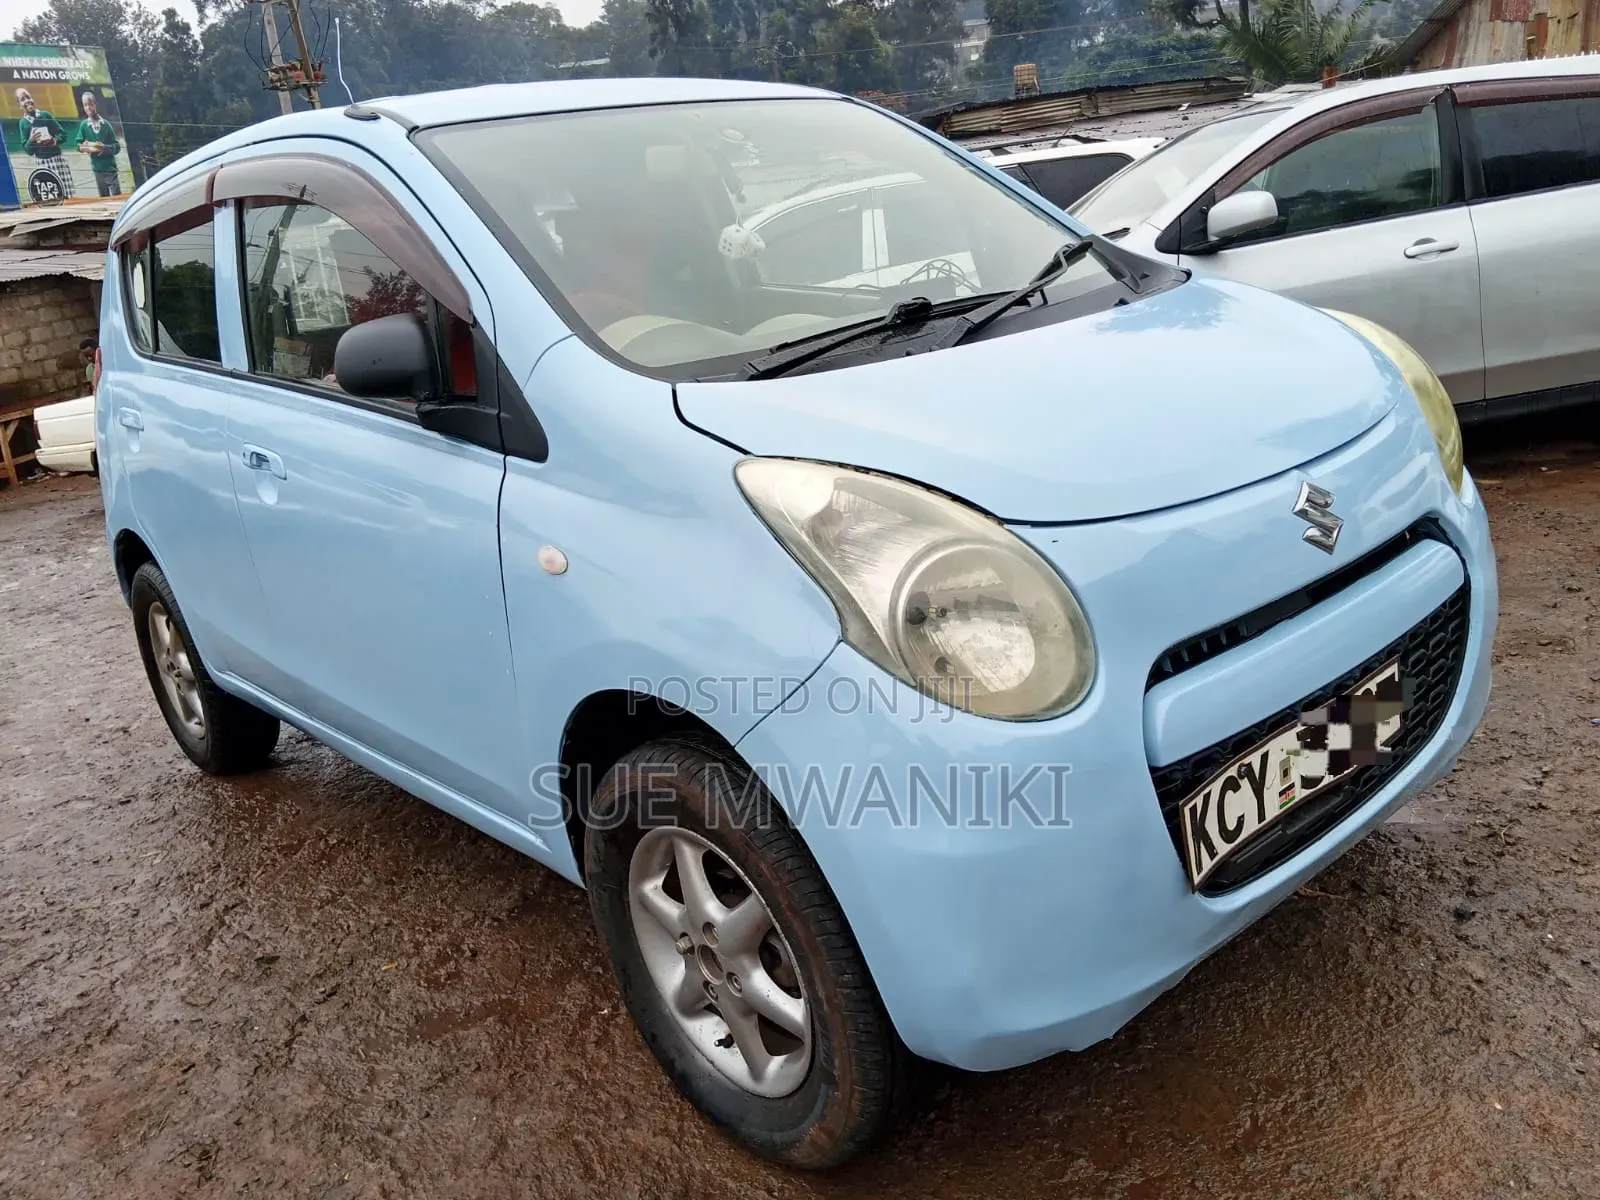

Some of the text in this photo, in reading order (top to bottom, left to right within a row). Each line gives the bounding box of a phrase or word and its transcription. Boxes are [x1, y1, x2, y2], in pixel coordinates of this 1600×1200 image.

[42, 58, 68, 67] CHILD
[13, 69, 90, 81] A NATION GROWS
[41, 191, 59, 201] EAT
[1188, 749, 1270, 876] KCY
